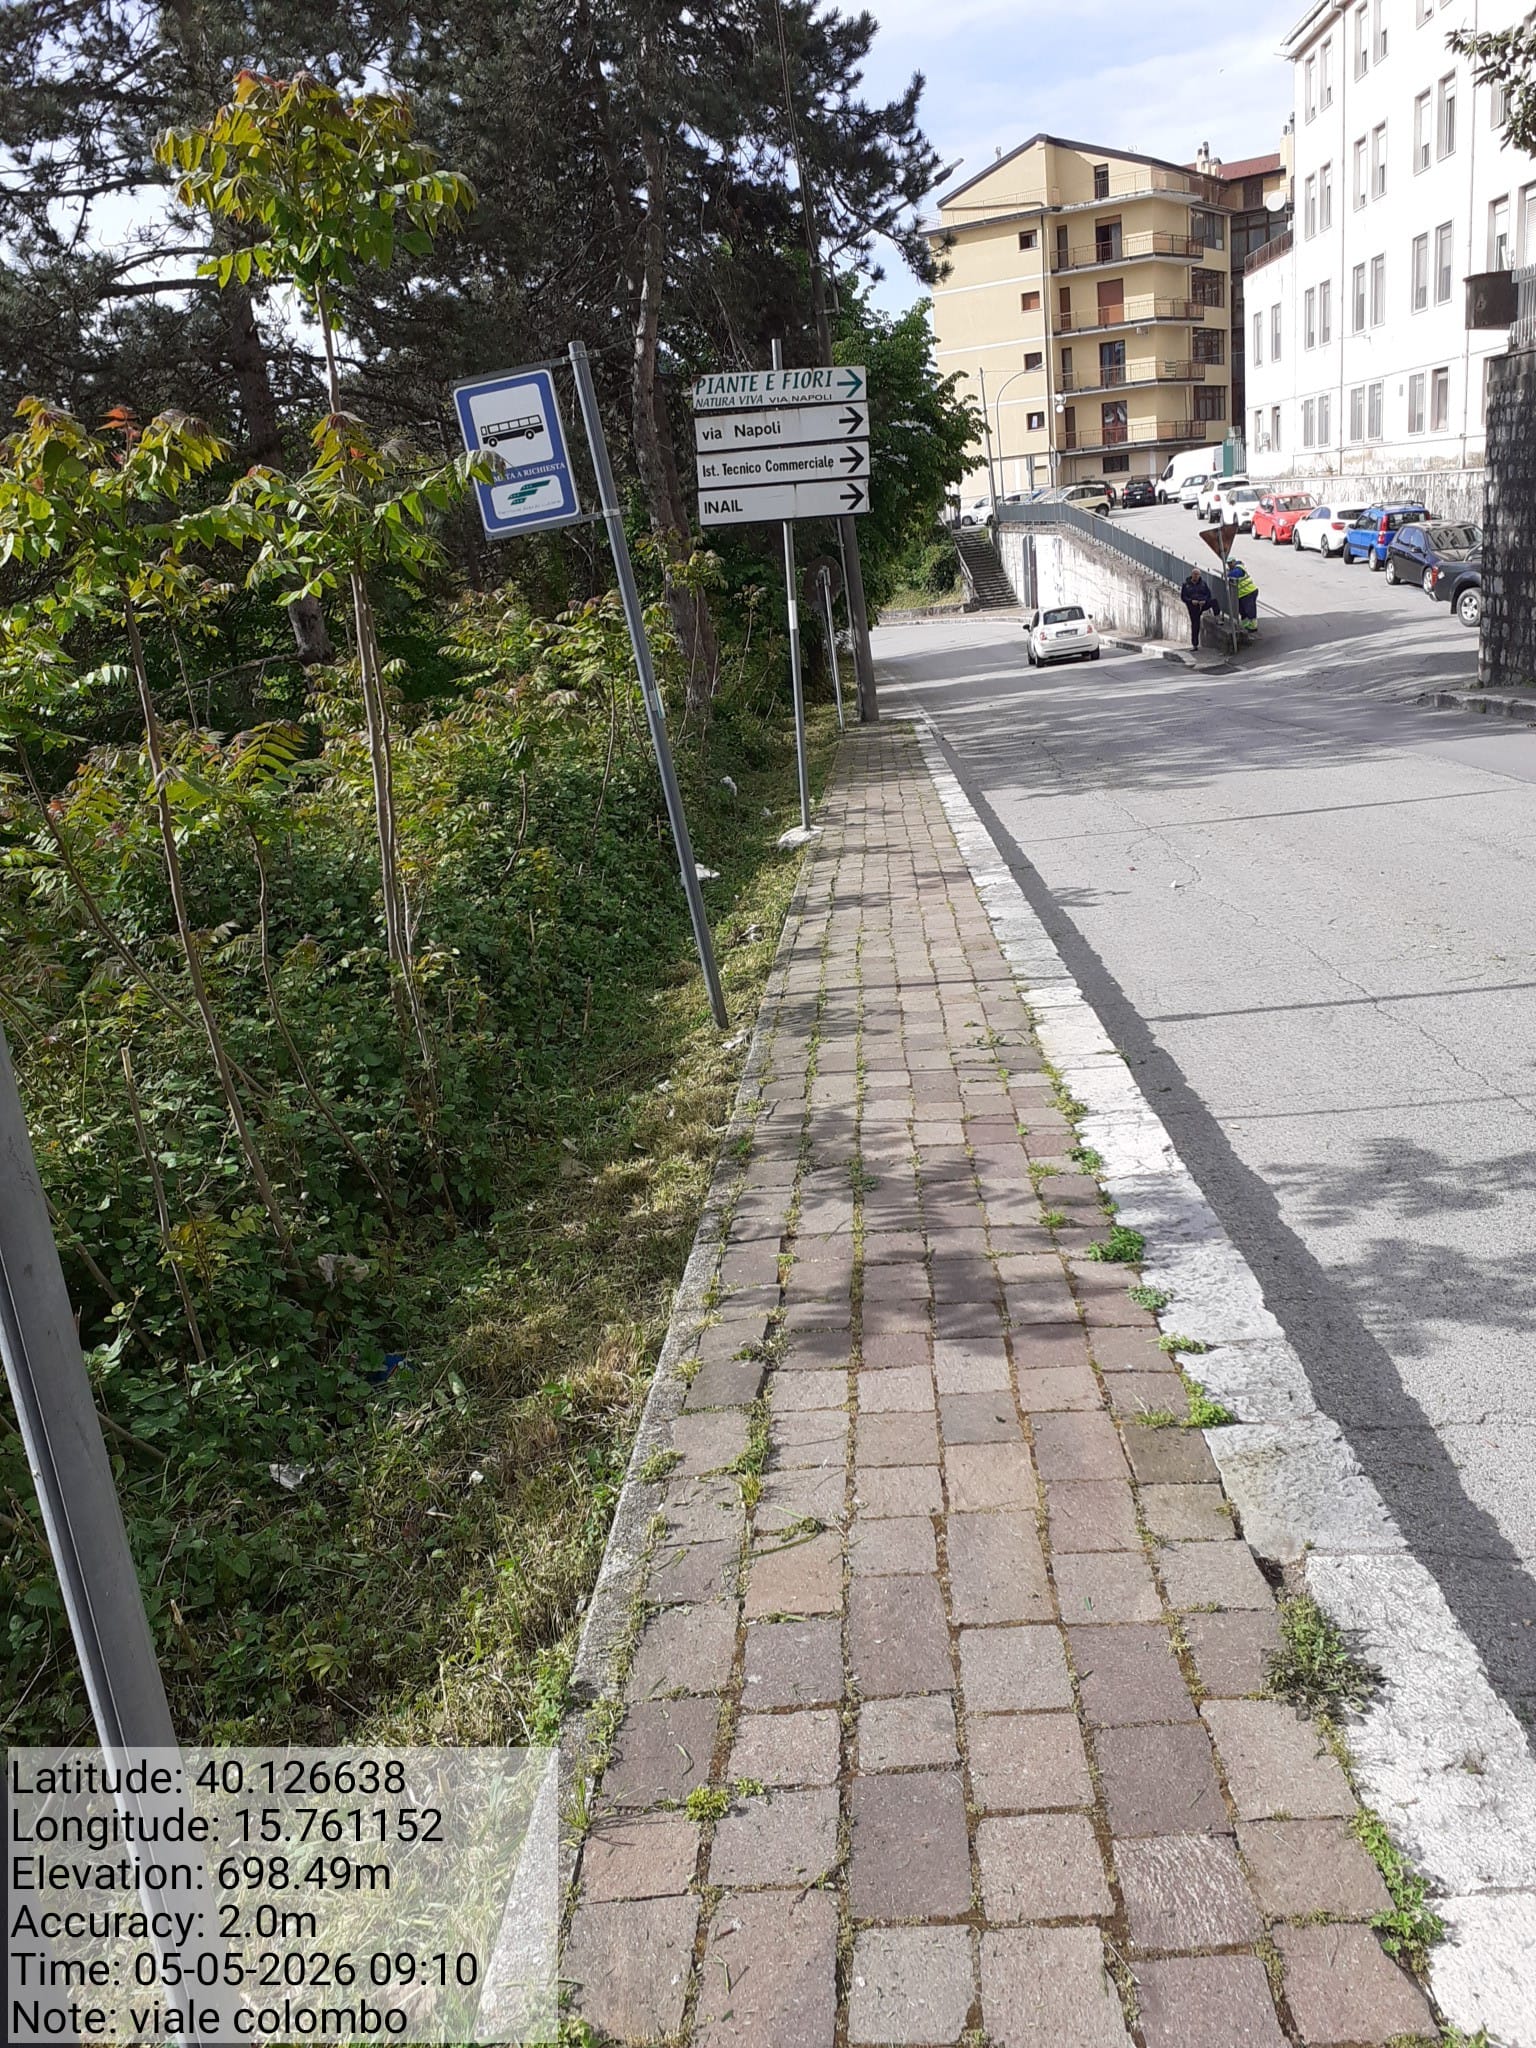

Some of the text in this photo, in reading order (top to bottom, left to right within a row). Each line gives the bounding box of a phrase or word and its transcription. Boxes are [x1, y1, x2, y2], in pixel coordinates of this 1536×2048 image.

[695, 370, 833, 395] PIANTE E FIORI
[695, 394, 832, 408] NATURA VIVA VIA NAPOLI
[702, 421, 781, 440] via Napoli
[523, 462, 566, 476] RICHIESTA
[702, 456, 834, 477] Ist. Tecnico Commerciale
[704, 500, 743, 514] INAIL
